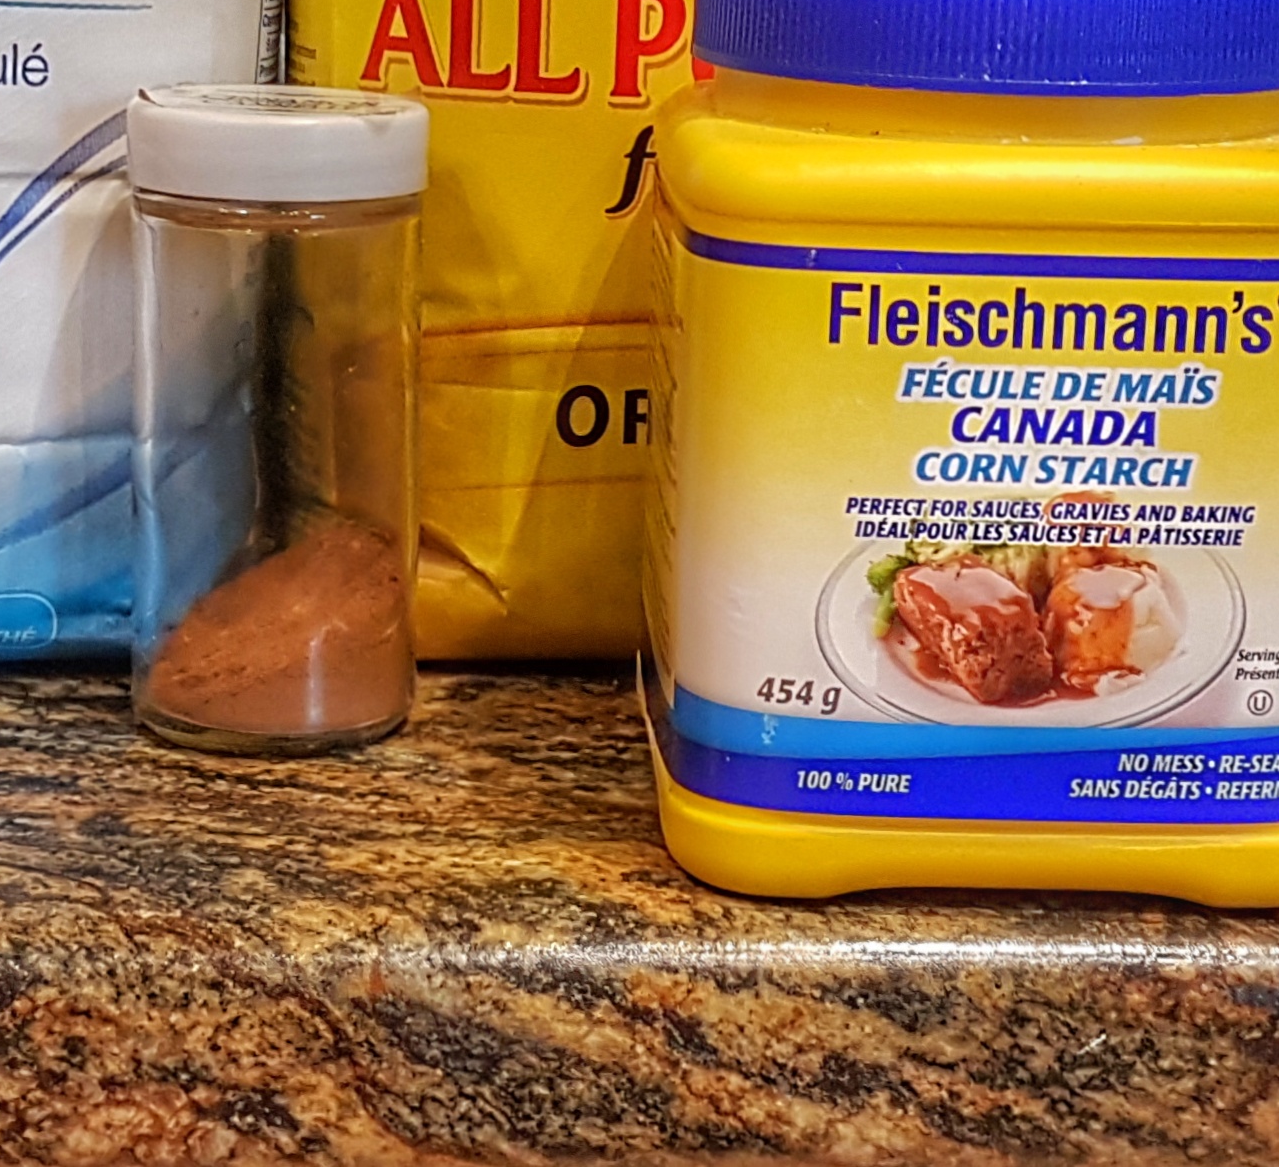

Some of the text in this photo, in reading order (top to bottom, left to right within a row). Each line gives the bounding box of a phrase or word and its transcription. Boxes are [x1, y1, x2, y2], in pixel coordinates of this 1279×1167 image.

[900, 360, 1218, 405] FÉCULE DE MAÏS
[949, 405, 1158, 448] CANADA
[914, 451, 1195, 488] CORN STARCH
[844, 497, 1256, 525] PERFECT FOR SAUCES, GRAVIES AND BAKING
[854, 516, 1245, 547] IDÉAL POUR LES SAUCES ET LA PÂTISSERIE
[756, 676, 843, 716] 454 g
[1117, 752, 1149, 773] NO
[1151, 753, 1205, 773] MESS
[796, 770, 912, 794] 100 % PURE
[1068, 777, 1122, 799] SANS
[1123, 776, 1203, 800] DÉGÂTS
